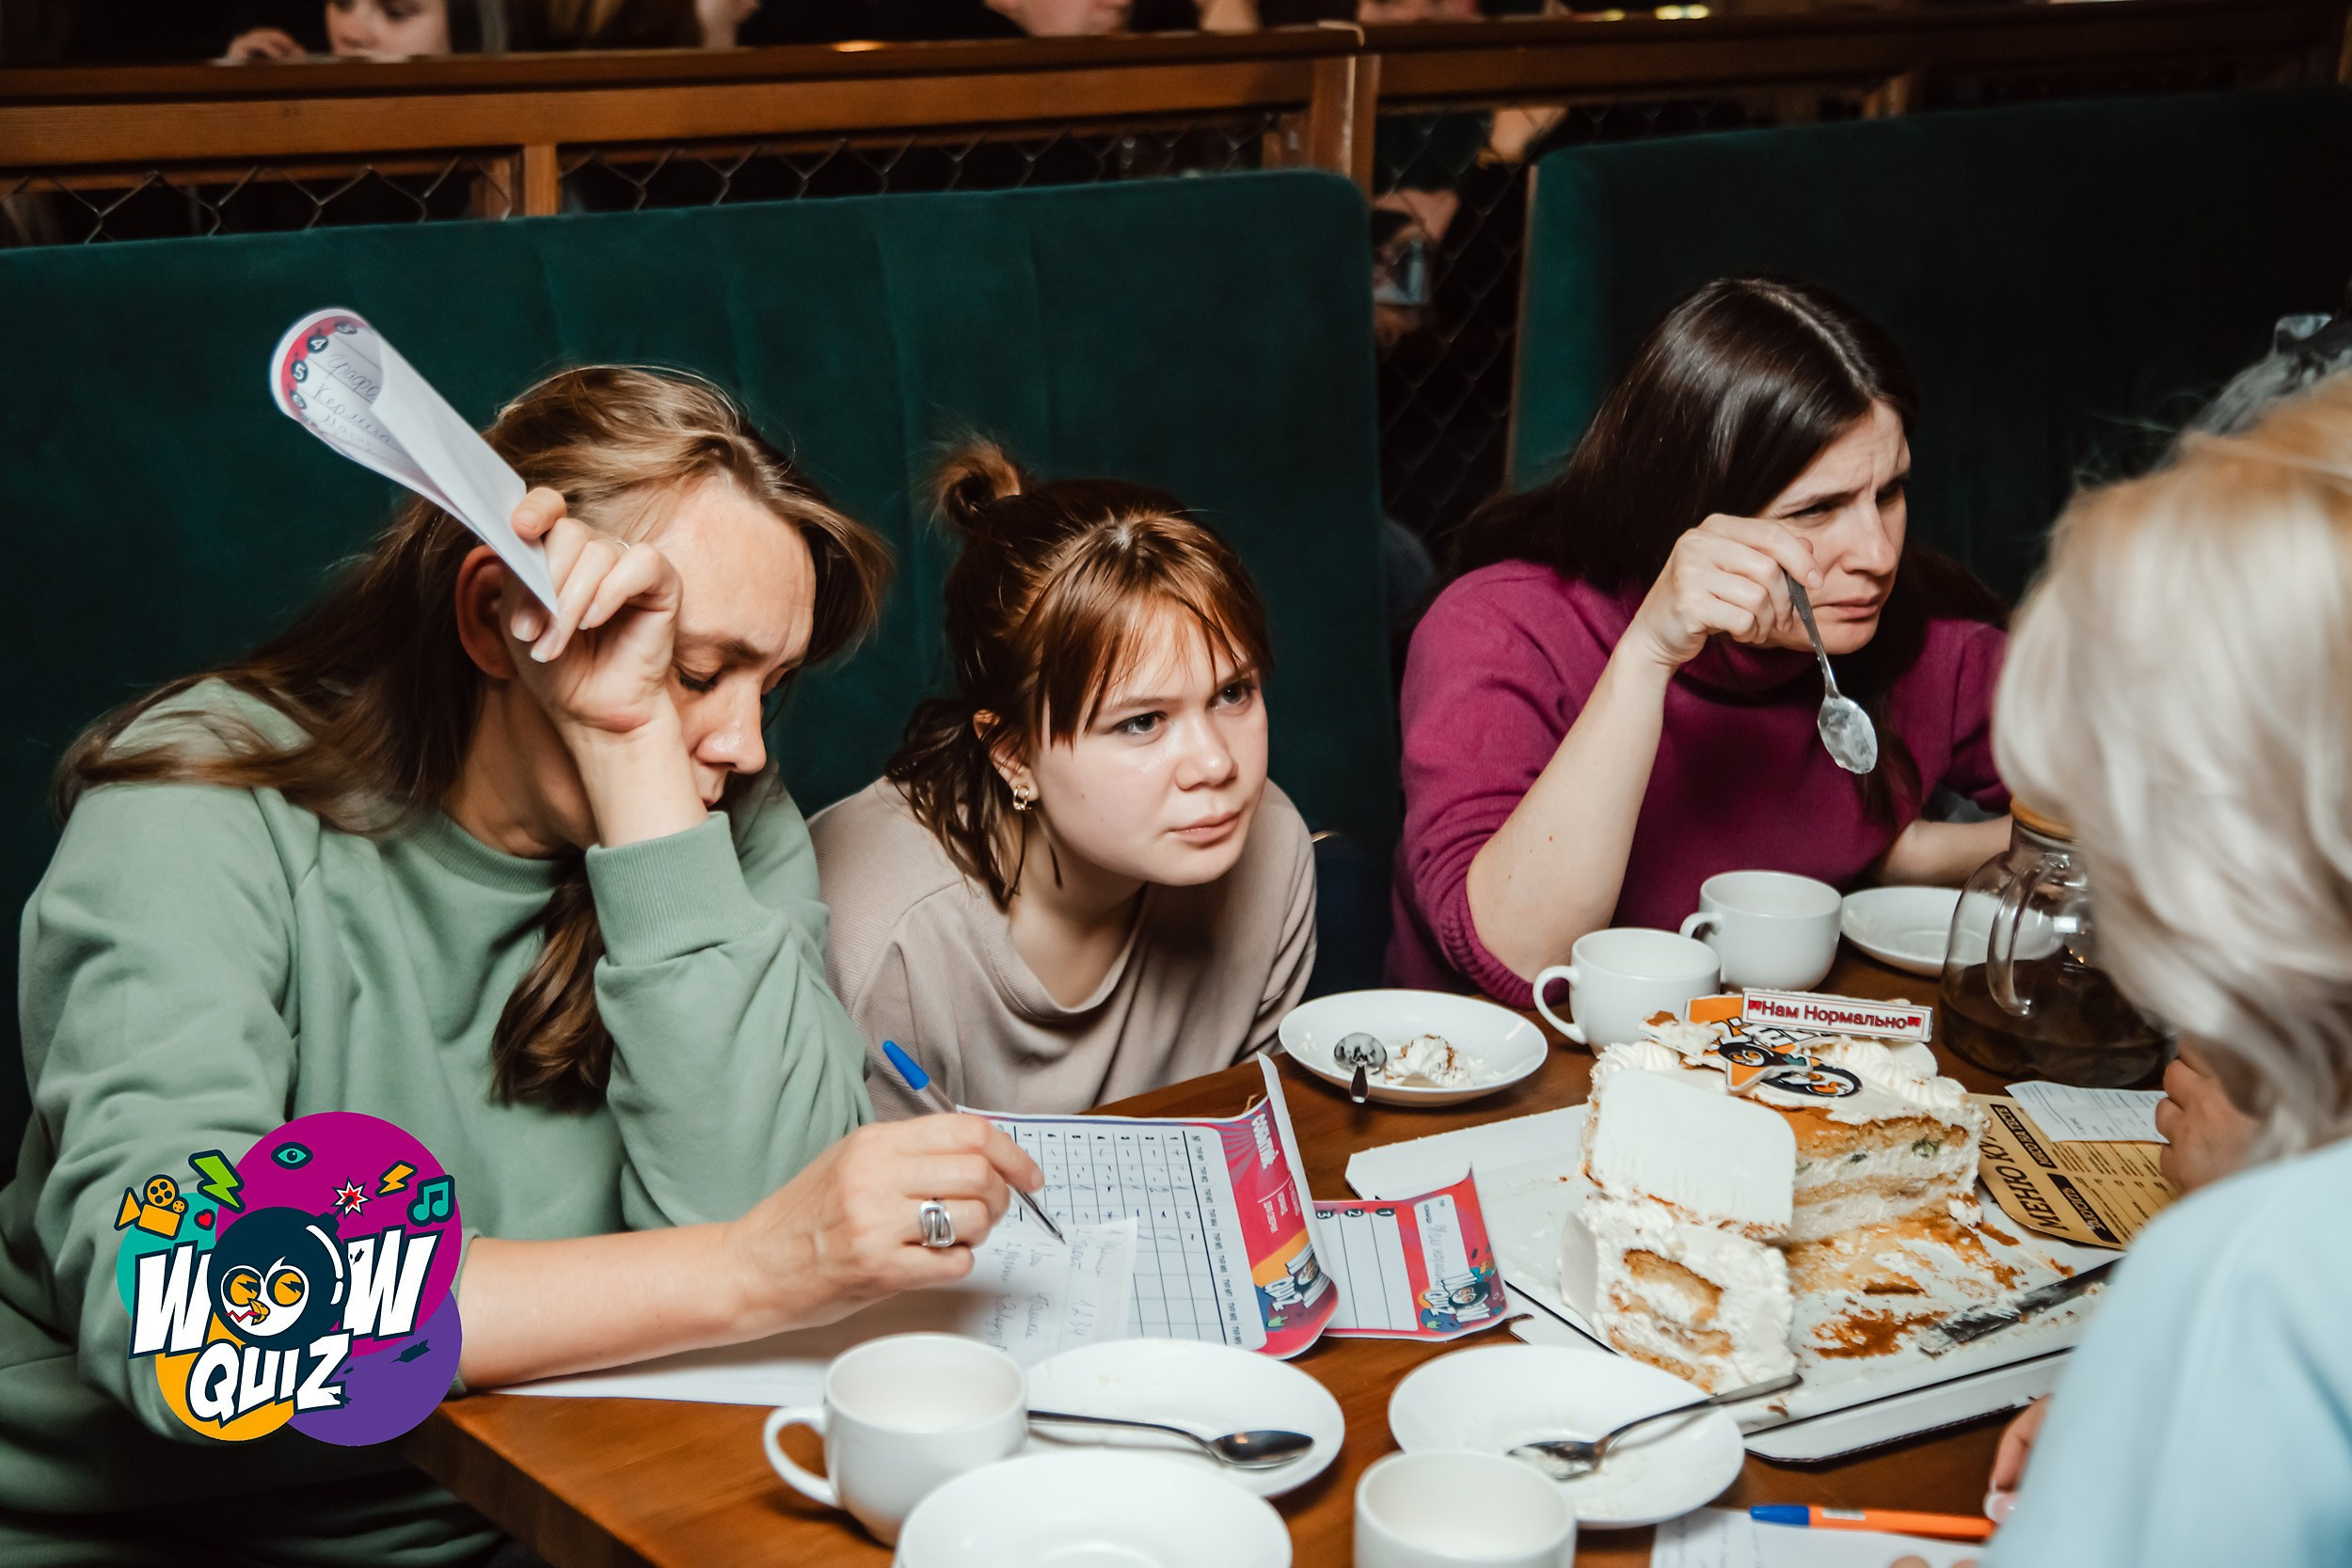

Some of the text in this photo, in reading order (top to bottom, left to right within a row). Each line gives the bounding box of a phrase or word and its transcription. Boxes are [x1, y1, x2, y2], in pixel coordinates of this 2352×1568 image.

[310, 340, 327, 351] 4
[293, 363, 307, 381] 5
[1994, 1165, 2071, 1231] МЕНЮ
